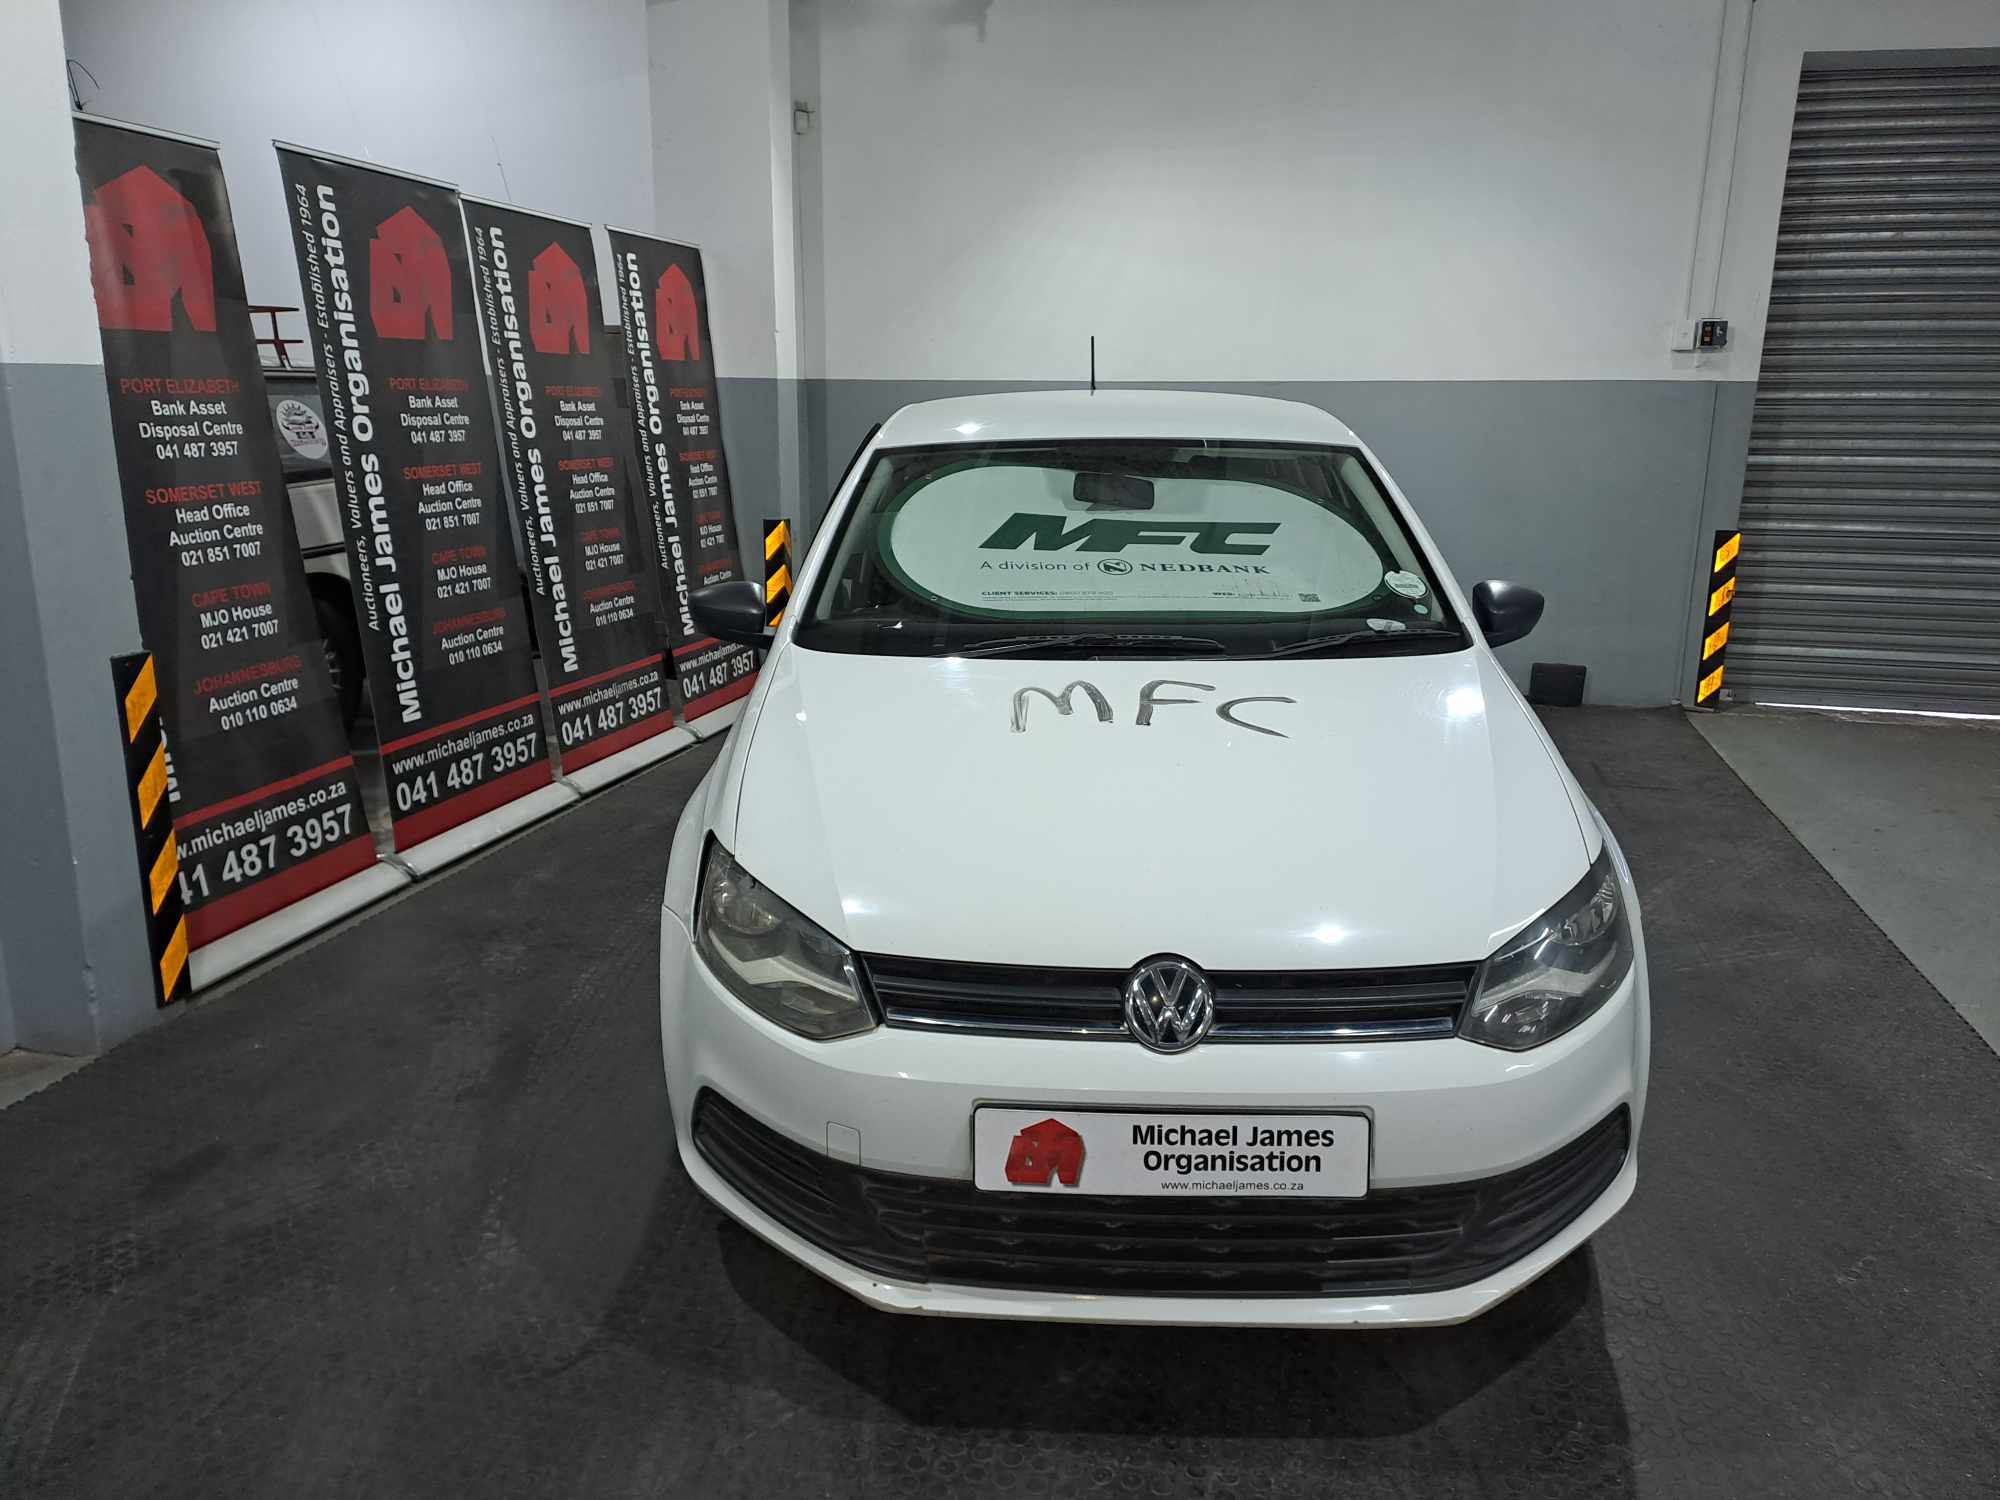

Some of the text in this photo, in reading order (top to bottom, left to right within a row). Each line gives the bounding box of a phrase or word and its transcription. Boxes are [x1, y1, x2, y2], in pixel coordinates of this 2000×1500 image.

[295, 183, 312, 226] 1964
[474, 227, 489, 266] 1964
[301, 230, 329, 329] Established
[480, 266, 501, 345] Established
[120, 379, 161, 395] PORT
[323, 343, 349, 430] Appraisers
[497, 357, 516, 429] Appraisers
[631, 365, 646, 427] Appraisers
[150, 400, 227, 416] Bank Asset
[409, 396, 458, 408] Bank Asset
[139, 421, 243, 440] Disposal Centre
[400, 413, 470, 428] Disposal Centre
[336, 434, 352, 465] and
[411, 430, 466, 443] 041 487 3957
[489, 227, 579, 673] Michael James Organisation
[505, 433, 520, 459] and
[626, 252, 695, 636] Michael James Organisation
[638, 429, 650, 452] and
[156, 441, 238, 460] 041 487 3957
[317, 184, 422, 724] Michael James Organisation
[422, 480, 473, 496] Head Office
[514, 460, 529, 511] Valuers
[644, 454, 656, 498] Valuers
[144, 480, 262, 504] SOMERSET WEST
[345, 470, 362, 529] Valuers
[569, 488, 593, 501] Auction
[175, 503, 250, 524] Head Office
[418, 497, 482, 515] Auction Centre
[169, 522, 263, 547] Auction Centre
[425, 512, 480, 531] 021 851 7007
[978, 512, 1282, 556] MFC
[181, 541, 261, 567] 021 851 7007
[525, 516, 545, 596] Auctioneers,
[980, 561, 993, 570] A
[998, 560, 1067, 571] division
[1073, 561, 1091, 572] of
[1140, 563, 1271, 575] NEDBANK
[356, 535, 380, 631] Auctioneers,
[437, 563, 487, 581] MJO House
[192, 586, 229, 607] CAPE
[437, 577, 491, 599] 021 421 7007
[200, 602, 273, 629] MJO House
[589, 598, 613, 614] Auction
[200, 619, 279, 650] 021 421 7007
[441, 625, 504, 650] Auction Centre
[449, 641, 503, 666] 010 110 0634
[682, 650, 754, 699] 041 487 3957
[208, 676, 299, 713] Auction Centre
[558, 670, 659, 716] www.michaeljames.co.za
[220, 695, 297, 731] 010 110 0634
[561, 687, 661, 747] 041 487 3957
[392, 712, 534, 776] www.michaeljames.co.za
[396, 732, 538, 812] 041 487 3957
[177, 780, 347, 861] w.michaeljames.co.za
[222, 833, 280, 884] 487
[287, 804, 352, 857] 3957
[1132, 1124, 1335, 1148] Michael James
[1142, 1150, 1322, 1174] Organisation
[1160, 1180, 1304, 1192] www.michaeljames.co.za
